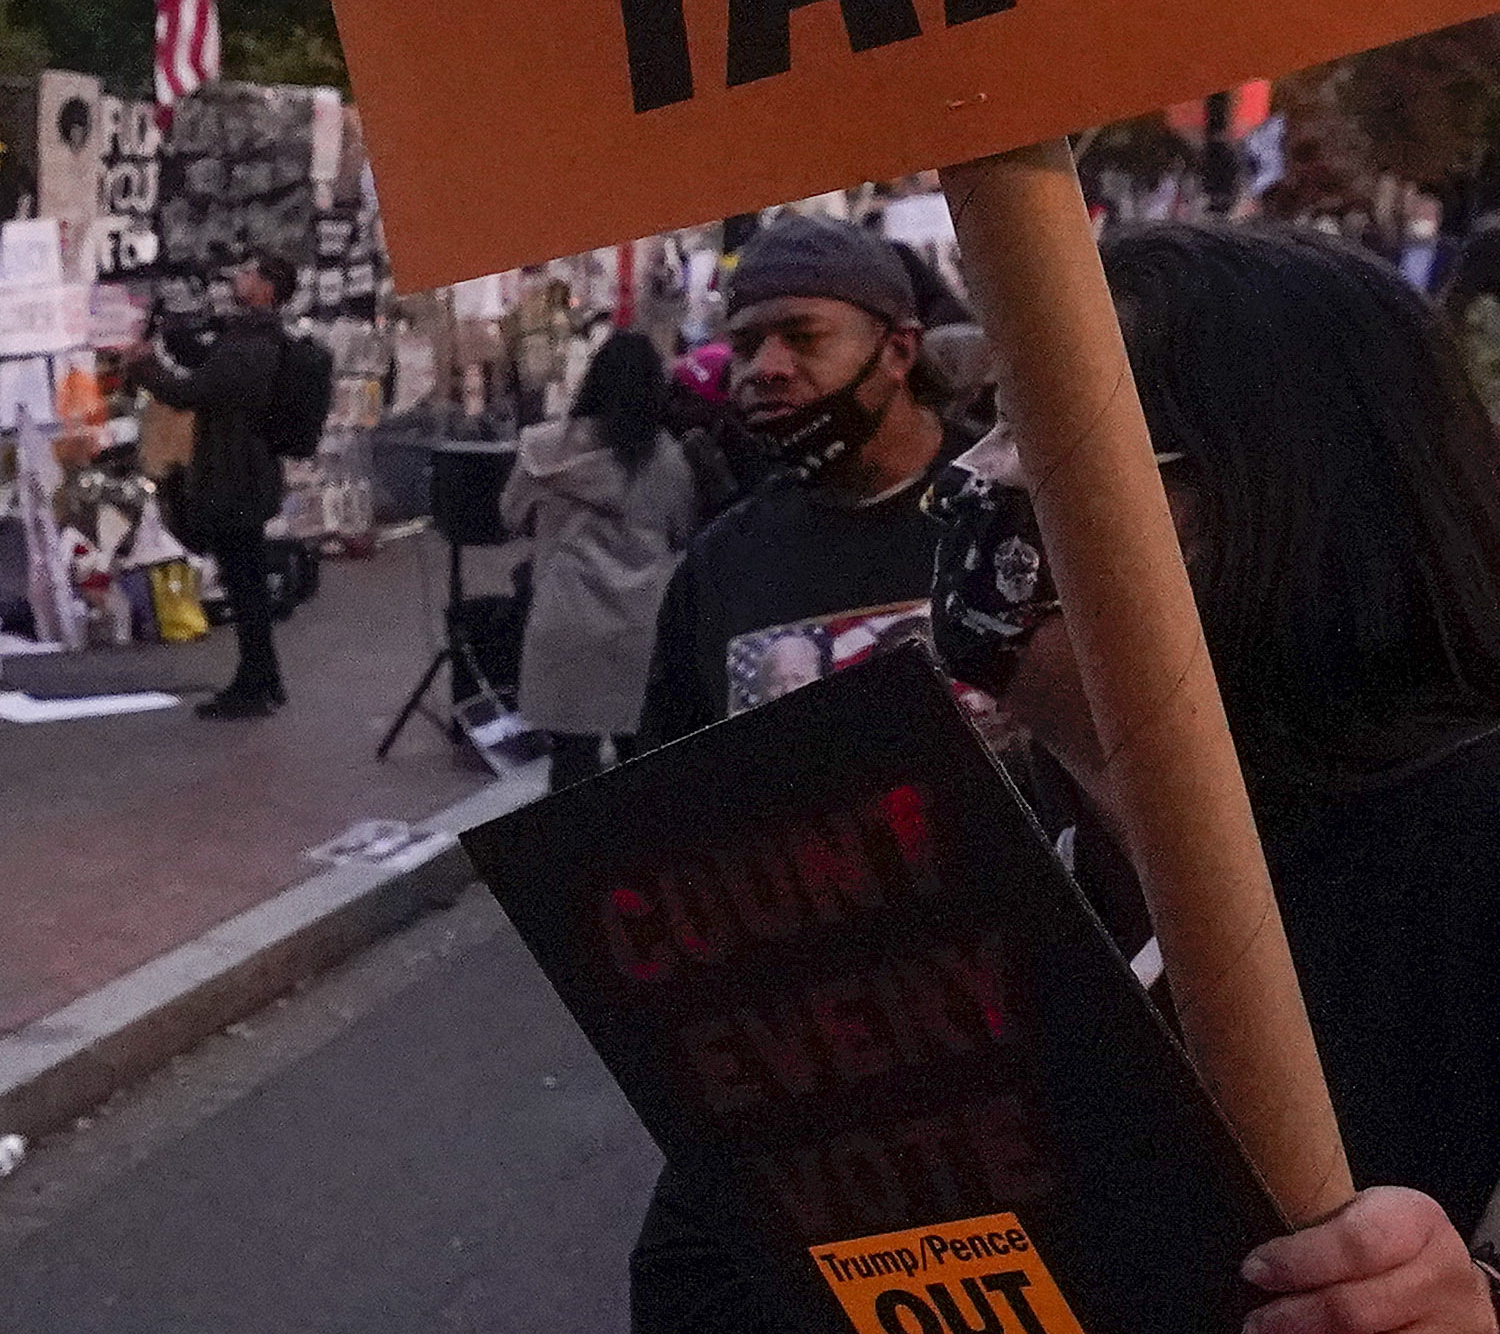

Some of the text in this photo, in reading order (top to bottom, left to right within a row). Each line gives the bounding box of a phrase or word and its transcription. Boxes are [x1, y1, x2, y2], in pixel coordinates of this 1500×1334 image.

[599, 781, 943, 985] COUNT
[678, 933, 1008, 1116] EVERY
[753, 1093, 1058, 1239] VOTE
[820, 1225, 1031, 1284] Trump/Pence
